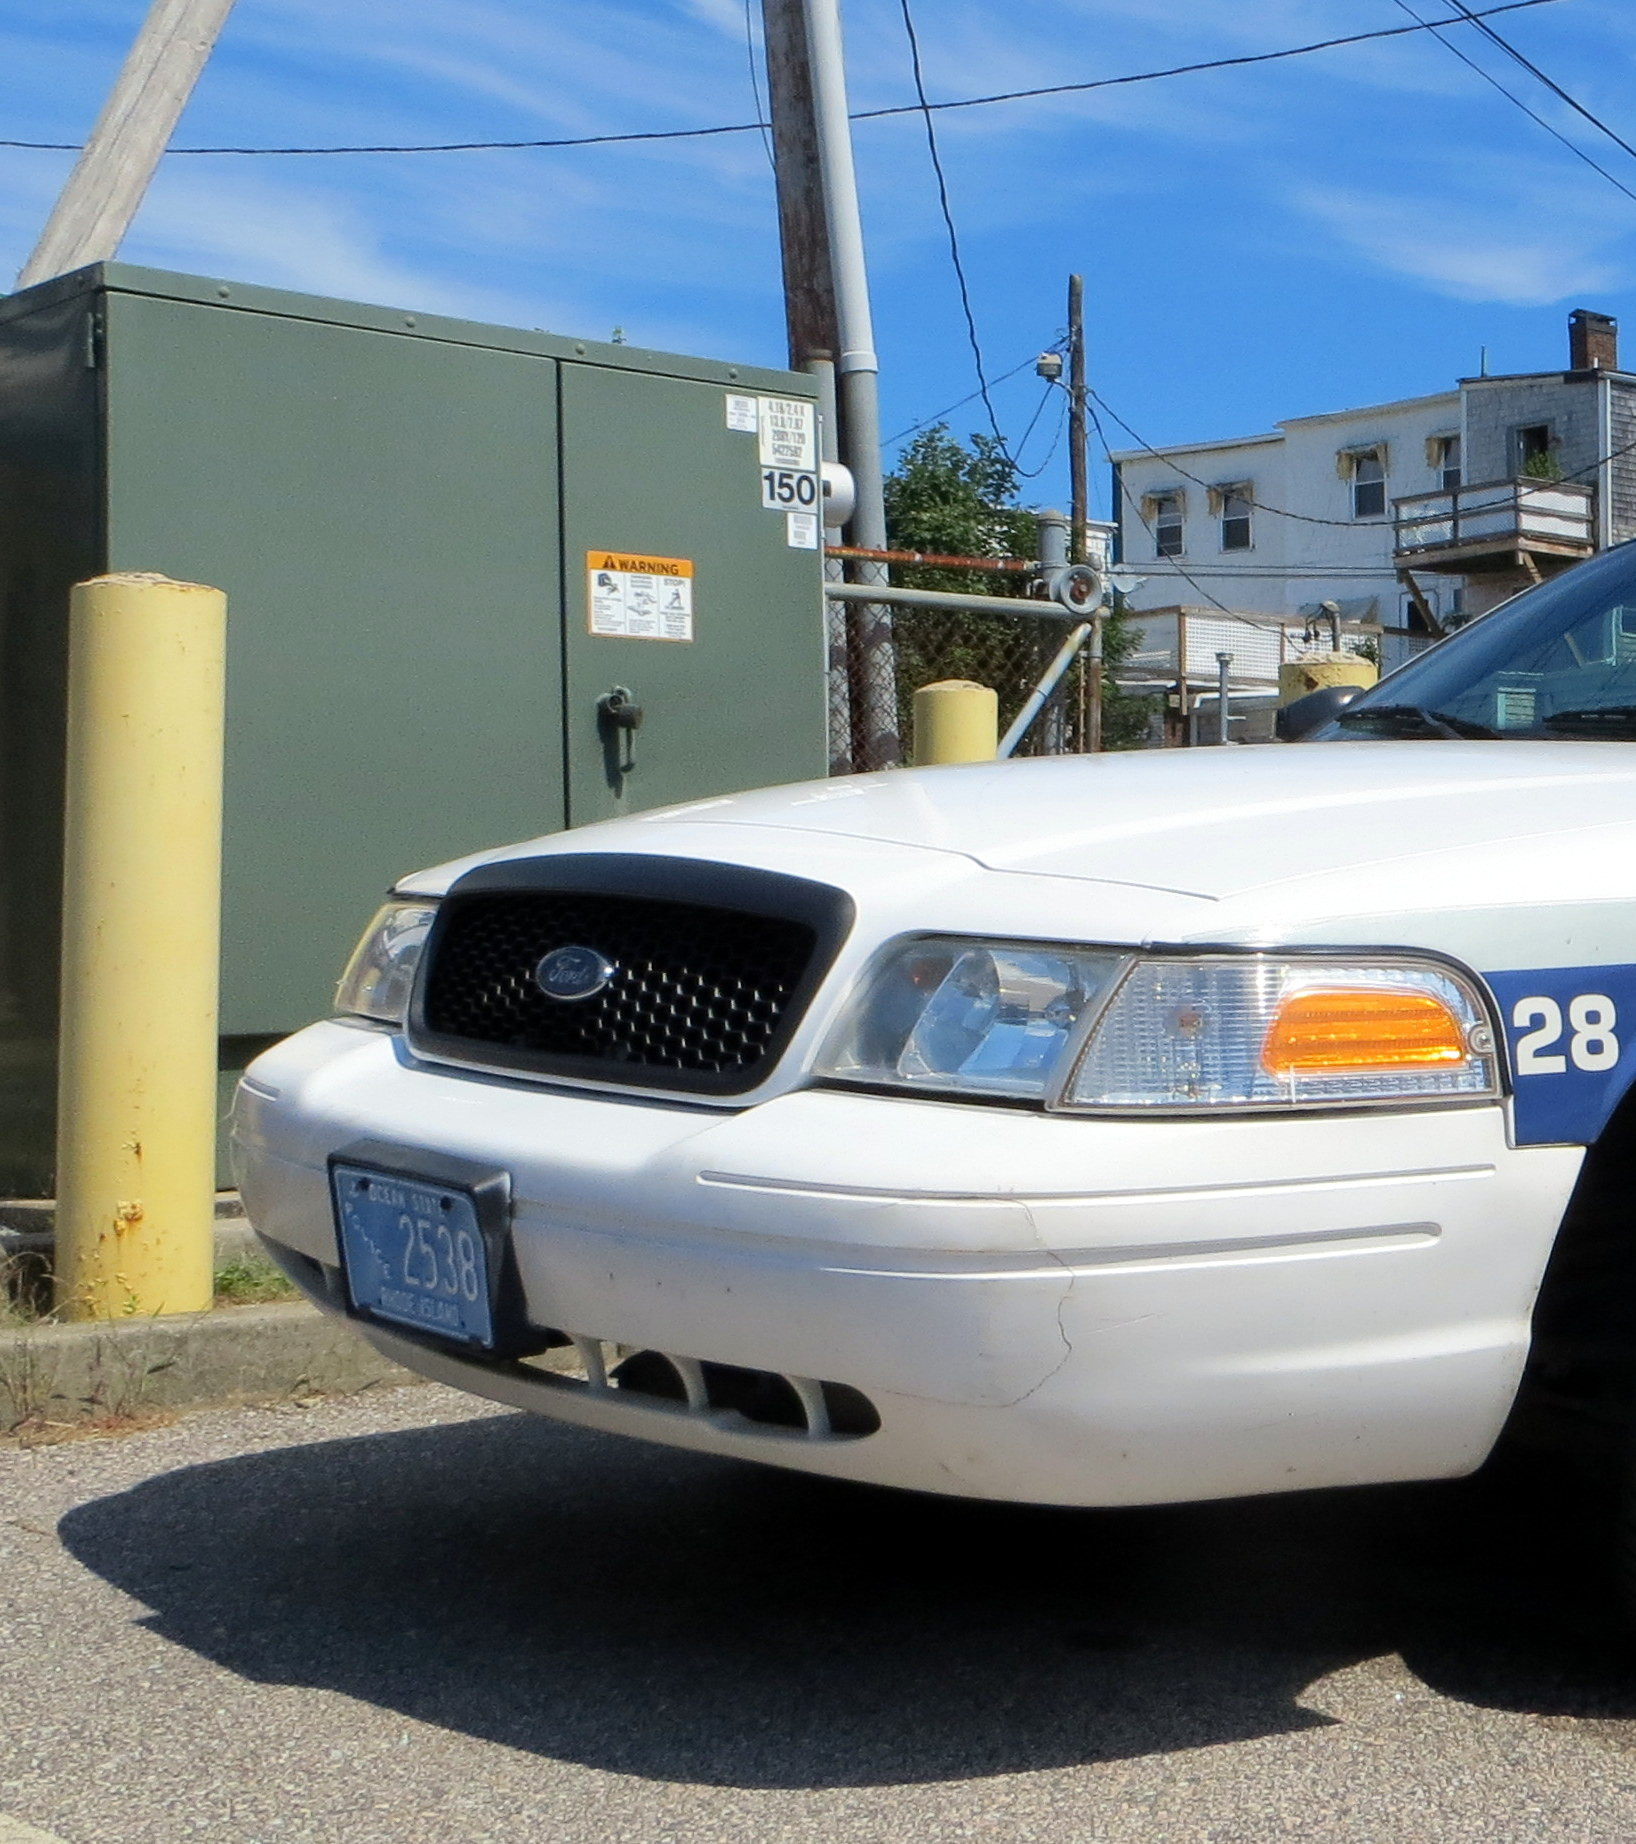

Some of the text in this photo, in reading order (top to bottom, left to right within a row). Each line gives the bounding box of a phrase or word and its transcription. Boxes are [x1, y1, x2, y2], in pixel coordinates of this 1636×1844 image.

[763, 471, 816, 506] 150
[618, 559, 679, 576] WARNING
[1513, 993, 1620, 1076] 28
[399, 1213, 480, 1302] 2538
